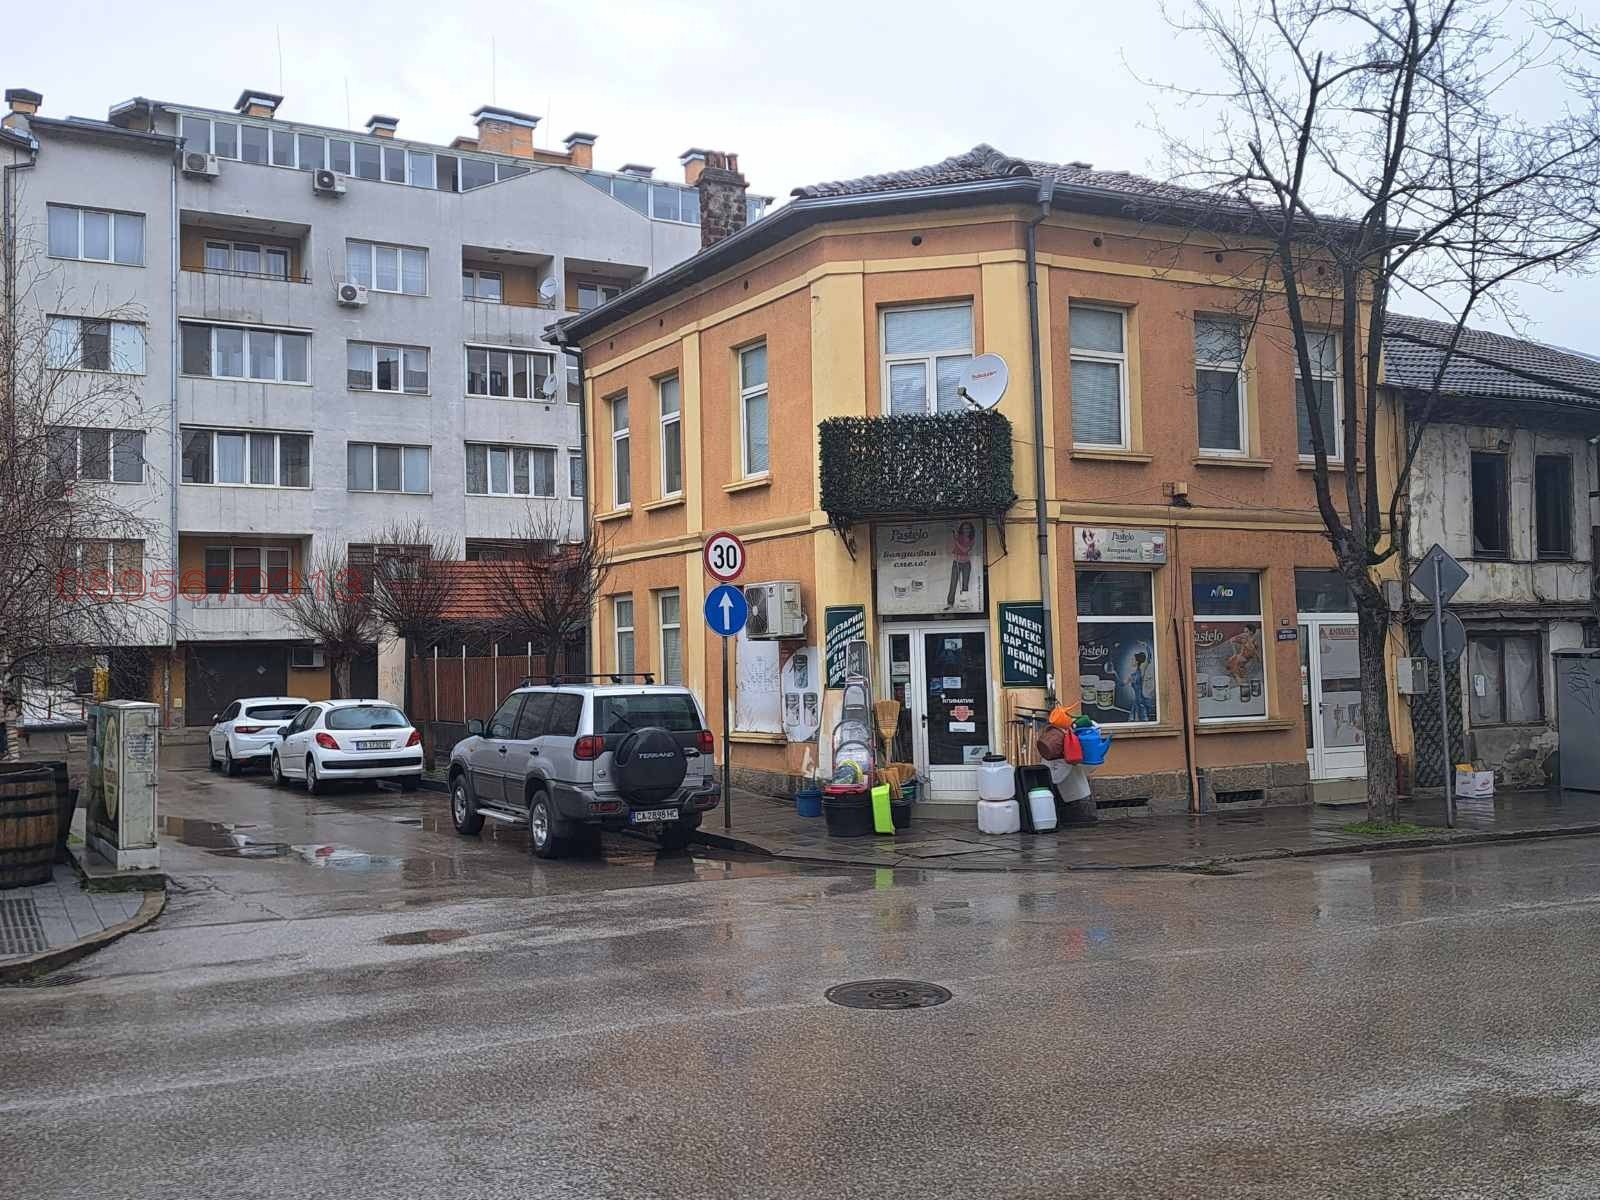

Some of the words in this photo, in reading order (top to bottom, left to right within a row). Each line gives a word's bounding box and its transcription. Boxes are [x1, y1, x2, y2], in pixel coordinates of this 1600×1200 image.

[889, 527, 929, 542] Pastelo
[1111, 531, 1135, 542] Pastelo
[713, 544, 737, 569] 30
[1005, 611, 1043, 634] ЦИМЕНТ
[1003, 633, 1021, 648] ВАР
[1007, 623, 1041, 644] ЛАТЕКС
[1007, 646, 1044, 669] ЛЕПИЛА
[1014, 660, 1038, 678] ГИПС
[639, 752, 675, 760] TERRANO
